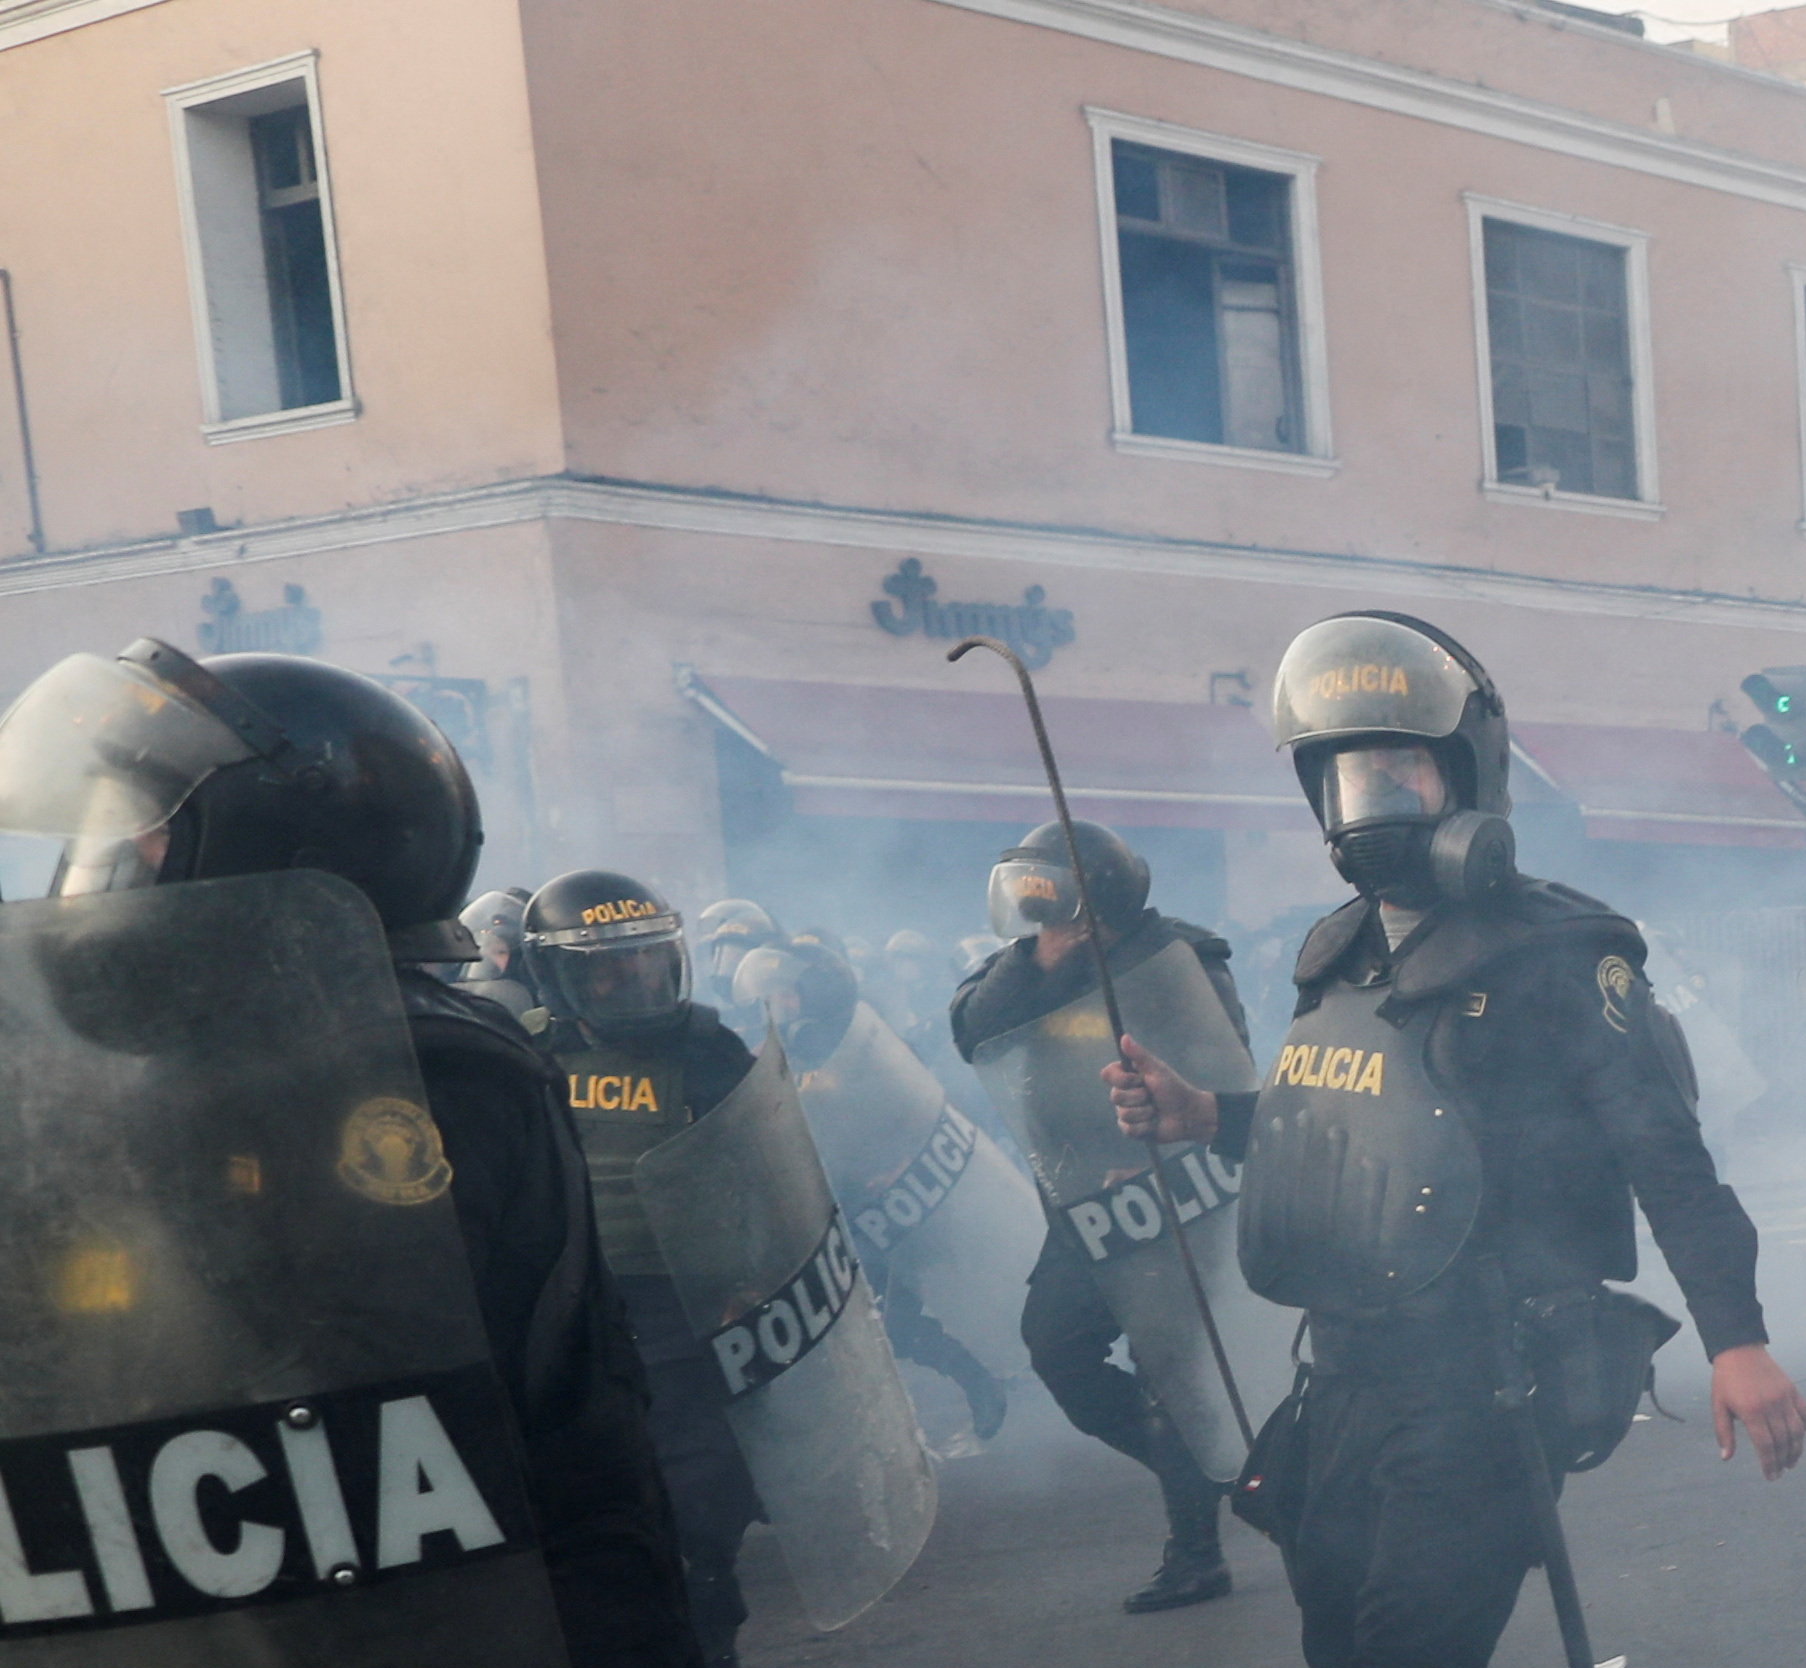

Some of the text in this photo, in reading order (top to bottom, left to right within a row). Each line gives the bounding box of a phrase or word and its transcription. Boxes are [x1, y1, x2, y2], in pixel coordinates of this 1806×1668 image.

[1309, 664, 1409, 698] POLICIA
[581, 899, 657, 926] POLICIA
[1274, 1044, 1384, 1096] POLICIA
